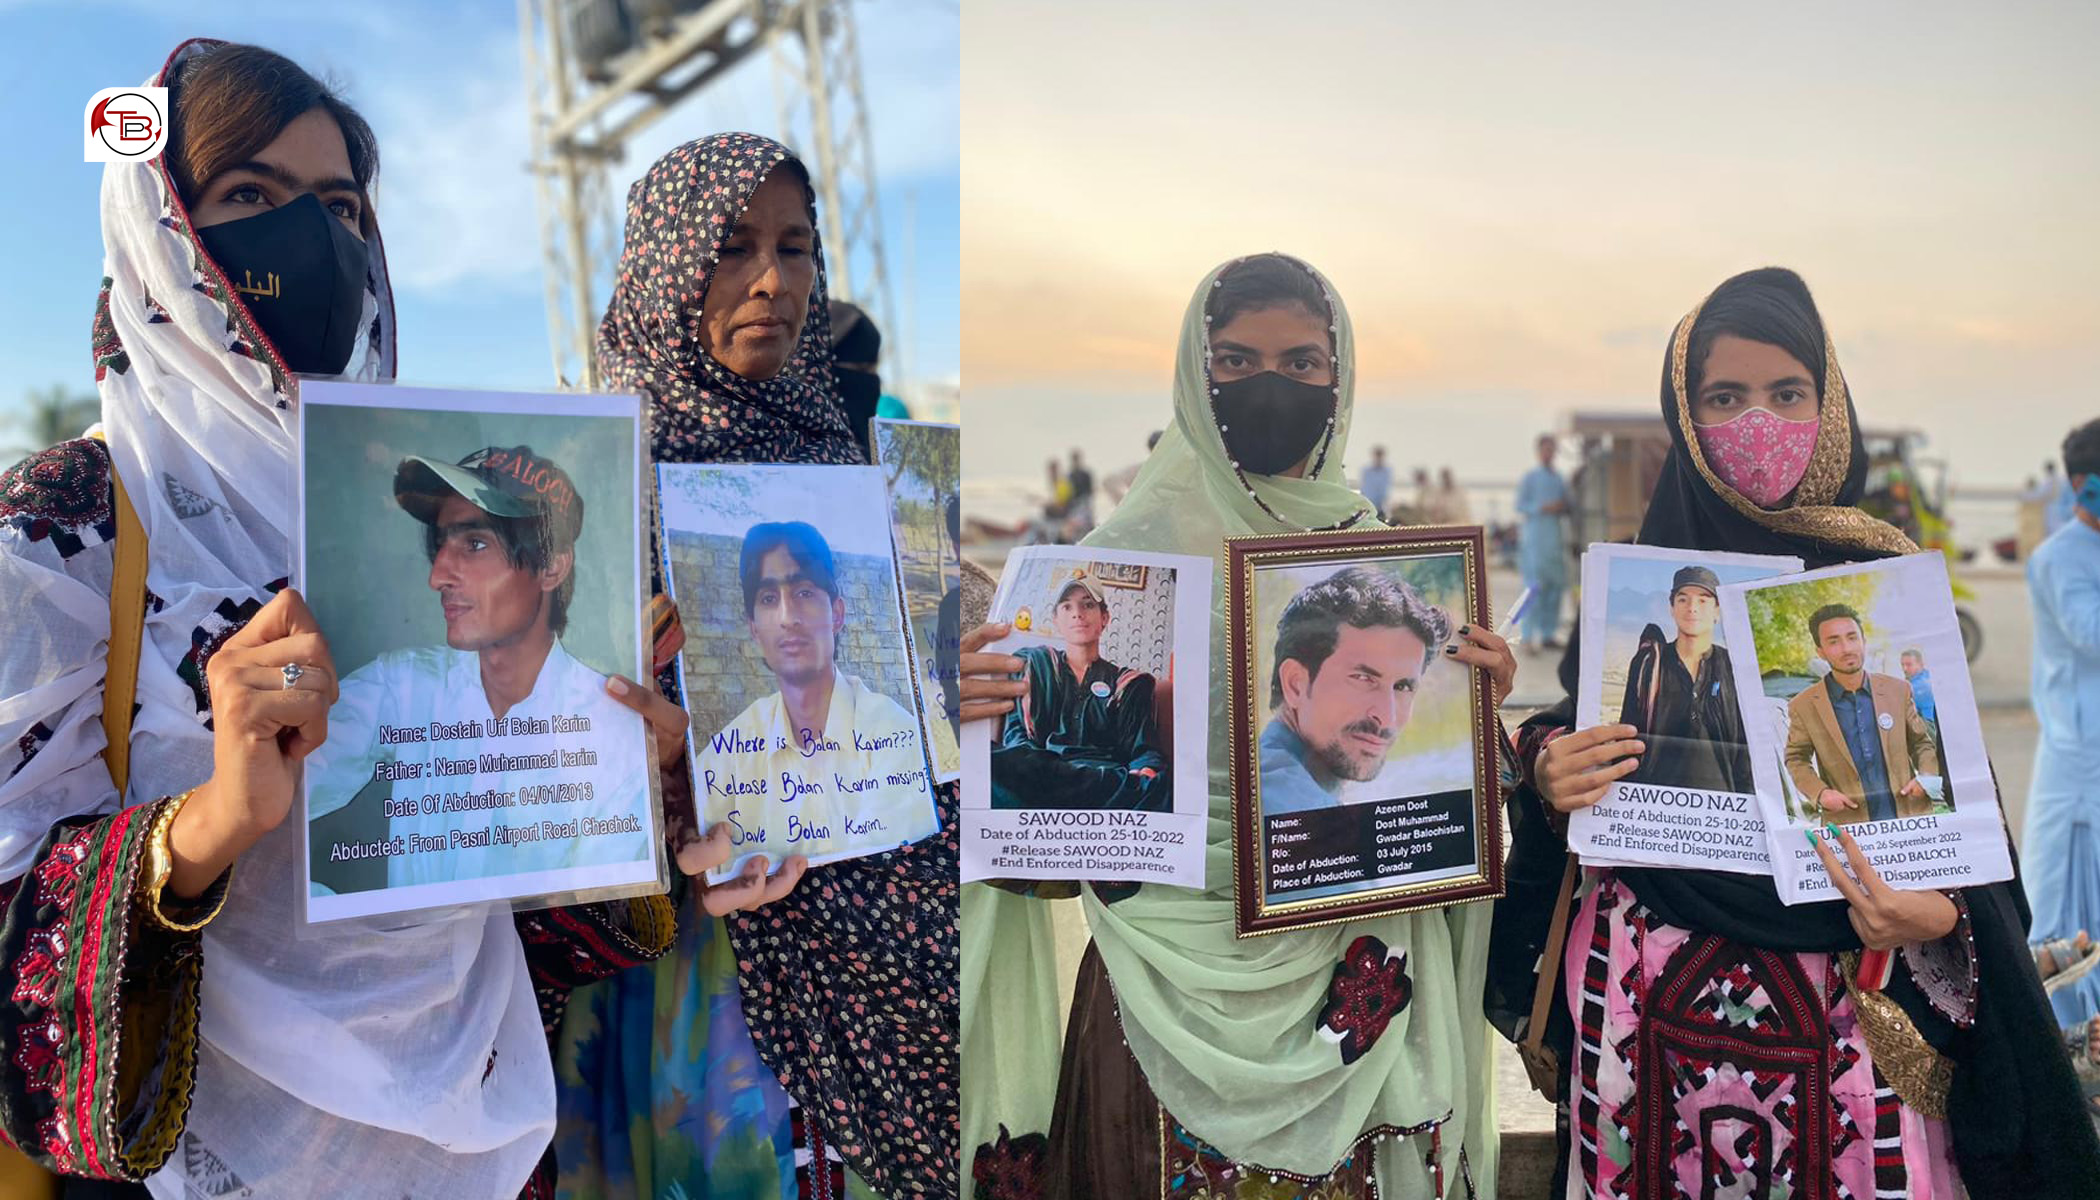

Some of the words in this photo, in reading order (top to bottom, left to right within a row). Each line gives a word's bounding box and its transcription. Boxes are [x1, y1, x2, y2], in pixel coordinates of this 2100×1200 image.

[484, 452, 574, 516] BALOCH
[380, 724, 427, 744] Name:
[431, 721, 483, 741] Dostain
[486, 719, 509, 737] Urf
[511, 717, 549, 736] Bolan
[552, 715, 590, 734] Karim
[711, 729, 765, 754] Where
[776, 734, 787, 750] is
[800, 728, 841, 757] Bolan
[375, 762, 423, 782] Father
[435, 757, 477, 778] Name
[480, 751, 557, 773] Muhammad
[561, 748, 597, 768] karim
[705, 769, 768, 798] Release
[834, 772, 879, 794] Karim
[384, 797, 418, 818] Date
[422, 794, 440, 814] Of
[443, 788, 515, 812] Abduction:
[519, 782, 593, 806] 04/01/2013
[1375, 802, 1406, 815] Azeem
[1407, 800, 1428, 812] Dost
[1618, 786, 1703, 808] SAWOOD
[1707, 795, 1748, 813] NAZ
[727, 810, 766, 846] Save
[786, 815, 830, 843] Bolan
[1018, 812, 1104, 827] SAWOOD
[1108, 812, 1148, 827] NAZ
[1271, 818, 1302, 830] Name:
[1375, 817, 1397, 830] Dost
[1398, 812, 1449, 827] Muhammad
[1592, 805, 1620, 819] Date
[1622, 808, 1636, 820] of
[1637, 810, 1701, 826] Abduction
[1705, 816, 1766, 833] 25-10-202
[330, 837, 405, 862] Abducted:
[409, 833, 446, 854] From
[451, 828, 489, 849] Pasni
[493, 823, 539, 847] Airport
[543, 820, 577, 840] Road
[581, 815, 642, 836] Chachok.
[980, 828, 1014, 840] Date
[1016, 828, 1030, 840] of
[1034, 829, 1107, 841] Abduction
[1110, 829, 1185, 845] 25-10-2022
[1271, 831, 1311, 845] F/Name:
[1376, 831, 1412, 844] Gwadar
[1413, 824, 1465, 839] Balochistan
[1609, 823, 1660, 838] #Release
[1662, 828, 1723, 844] SAWOOD
[1725, 834, 1753, 847] NAZ
[1813, 824, 1877, 841] UHAD
[1881, 817, 1938, 836] BALOCH
[1591, 834, 1621, 848] #End
[1625, 837, 1679, 853] Enforced
[1876, 840, 1888, 850] 26
[1889, 835, 1936, 850] September
[1939, 832, 1962, 843] 2022
[1002, 845, 1061, 857] #Release
[1063, 845, 1131, 857] SAWOOD
[1133, 847, 1165, 859] NAZ
[1272, 847, 1291, 859] R/o:
[1377, 848, 1388, 859] 03
[1389, 846, 1409, 860] July
[1410, 843, 1433, 855] 2015
[1867, 852, 1906, 866] LSHAD
[1909, 848, 1957, 862] BALOCH
[991, 857, 1023, 869] #End
[1026, 858, 1083, 870] Enforced
[1086, 859, 1176, 874] Disappearence
[1272, 861, 1295, 874] Date
[1296, 860, 1306, 871] of
[1309, 854, 1359, 869] Abduction:
[1377, 861, 1413, 874] Gwadar
[1885, 864, 1972, 883] Disappearence
[1273, 875, 1300, 890] Place
[1302, 874, 1312, 886] of
[1314, 868, 1364, 884] Abduction:
[1799, 878, 1828, 891] #End
